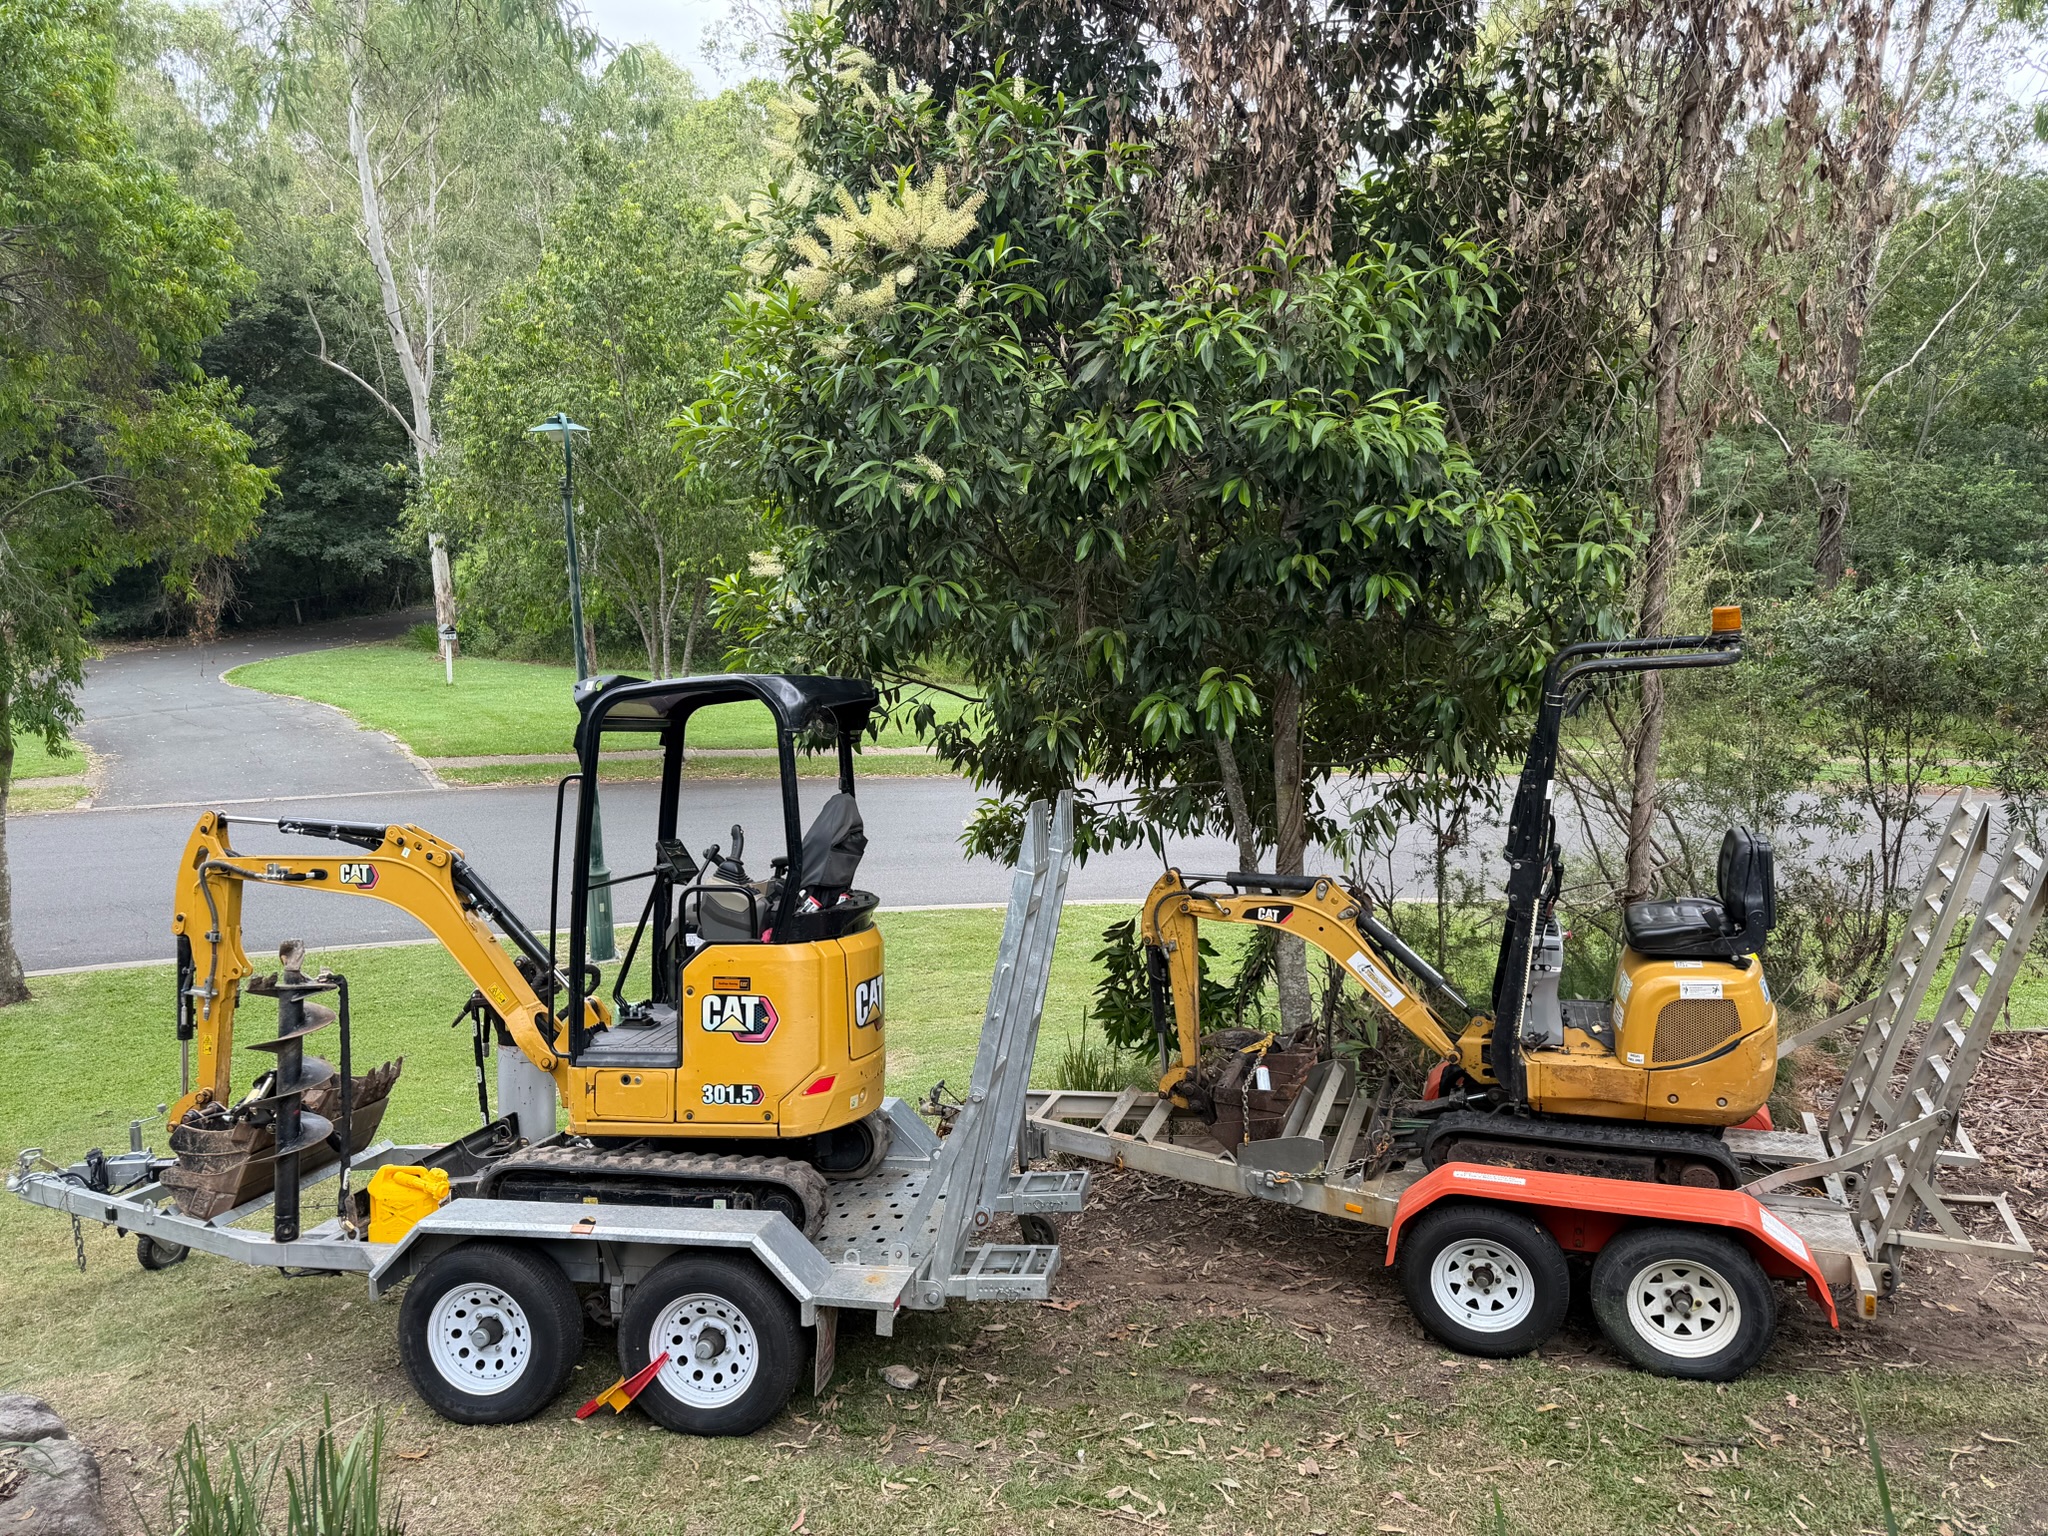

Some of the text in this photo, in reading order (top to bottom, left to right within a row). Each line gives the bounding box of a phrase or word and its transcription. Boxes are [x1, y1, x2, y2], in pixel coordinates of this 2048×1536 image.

[340, 864, 369, 884] CAT
[1257, 908, 1279, 922] CAT
[856, 974, 883, 1026] CAT
[702, 995, 759, 1031] CAT
[702, 1084, 753, 1104] 301.5
